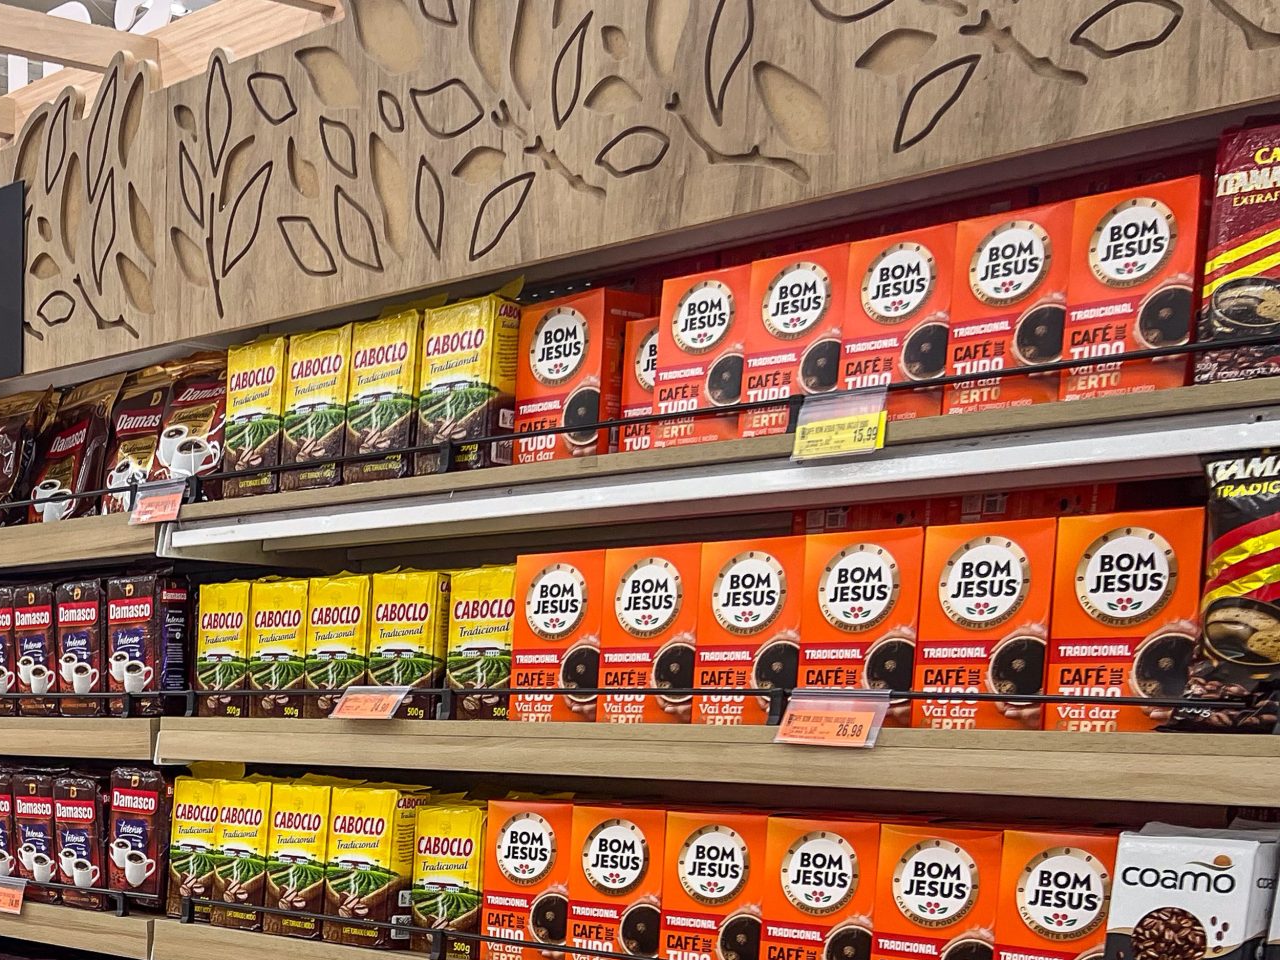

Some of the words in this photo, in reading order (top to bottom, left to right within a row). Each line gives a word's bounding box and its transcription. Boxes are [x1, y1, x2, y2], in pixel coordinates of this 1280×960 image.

[1110, 219, 1159, 241] BOM
[1100, 237, 1164, 262] JESUS
[779, 280, 817, 301] BOM
[772, 295, 821, 317] JESUS
[1070, 303, 1133, 321] TRADICIONAL
[426, 328, 484, 357] CABOCLO
[1070, 324, 1112, 346] CAFÉ
[353, 341, 408, 369] CABOCLO
[430, 353, 479, 375] Tradicional
[747, 353, 797, 368] TRADICIONAL
[291, 354, 342, 380] CABOCLO
[357, 366, 402, 386] Tradicional
[229, 366, 276, 392] CABOCLO
[853, 426, 877, 444] 15,99
[1100, 552, 1156, 572] BOM
[837, 567, 882, 584] BOM
[1089, 573, 1164, 593] JESUS
[540, 584, 575, 598] BOM
[829, 584, 888, 603] JESUS
[59, 606, 96, 621] Damasco
[110, 603, 150, 619] Damasco
[311, 606, 360, 625] CABOCLO
[376, 602, 428, 622] CABOCLO
[454, 598, 515, 619] CABOCLO
[533, 599, 579, 615] JESUS
[15, 611, 49, 626] Damasco
[201, 612, 243, 629] CABOCLO
[314, 628, 356, 641] Tradicional
[379, 625, 423, 639] Tradicional
[459, 622, 510, 637] Tradicional
[805, 648, 863, 660] TRADICIONAL
[1059, 644, 1130, 658] TRADICIONAL
[1060, 666, 1105, 686] CAFÉ
[1109, 668, 1124, 685] QUE
[407, 707, 424, 718] 500g
[1057, 705, 1086, 720] Vai
[1089, 706, 1119, 719] dar
[836, 724, 863, 738] 26,98
[17, 800, 52, 815] Damasco
[113, 791, 155, 810] Damasco
[175, 804, 218, 823] CABOCLO
[177, 824, 215, 836] Tradicional
[333, 815, 385, 836] CABOCLO
[337, 839, 380, 850] Tradicional
[418, 836, 474, 857] CABOCLO
[599, 838, 635, 854] BOM
[421, 860, 468, 872] Tradicional
[591, 853, 640, 871] JESUS
[913, 862, 961, 881] BOM
[904, 879, 968, 900] JESUS
[1039, 870, 1092, 891] BOM
[1121, 866, 1236, 894] coamo
[1028, 890, 1098, 912] JESUS
